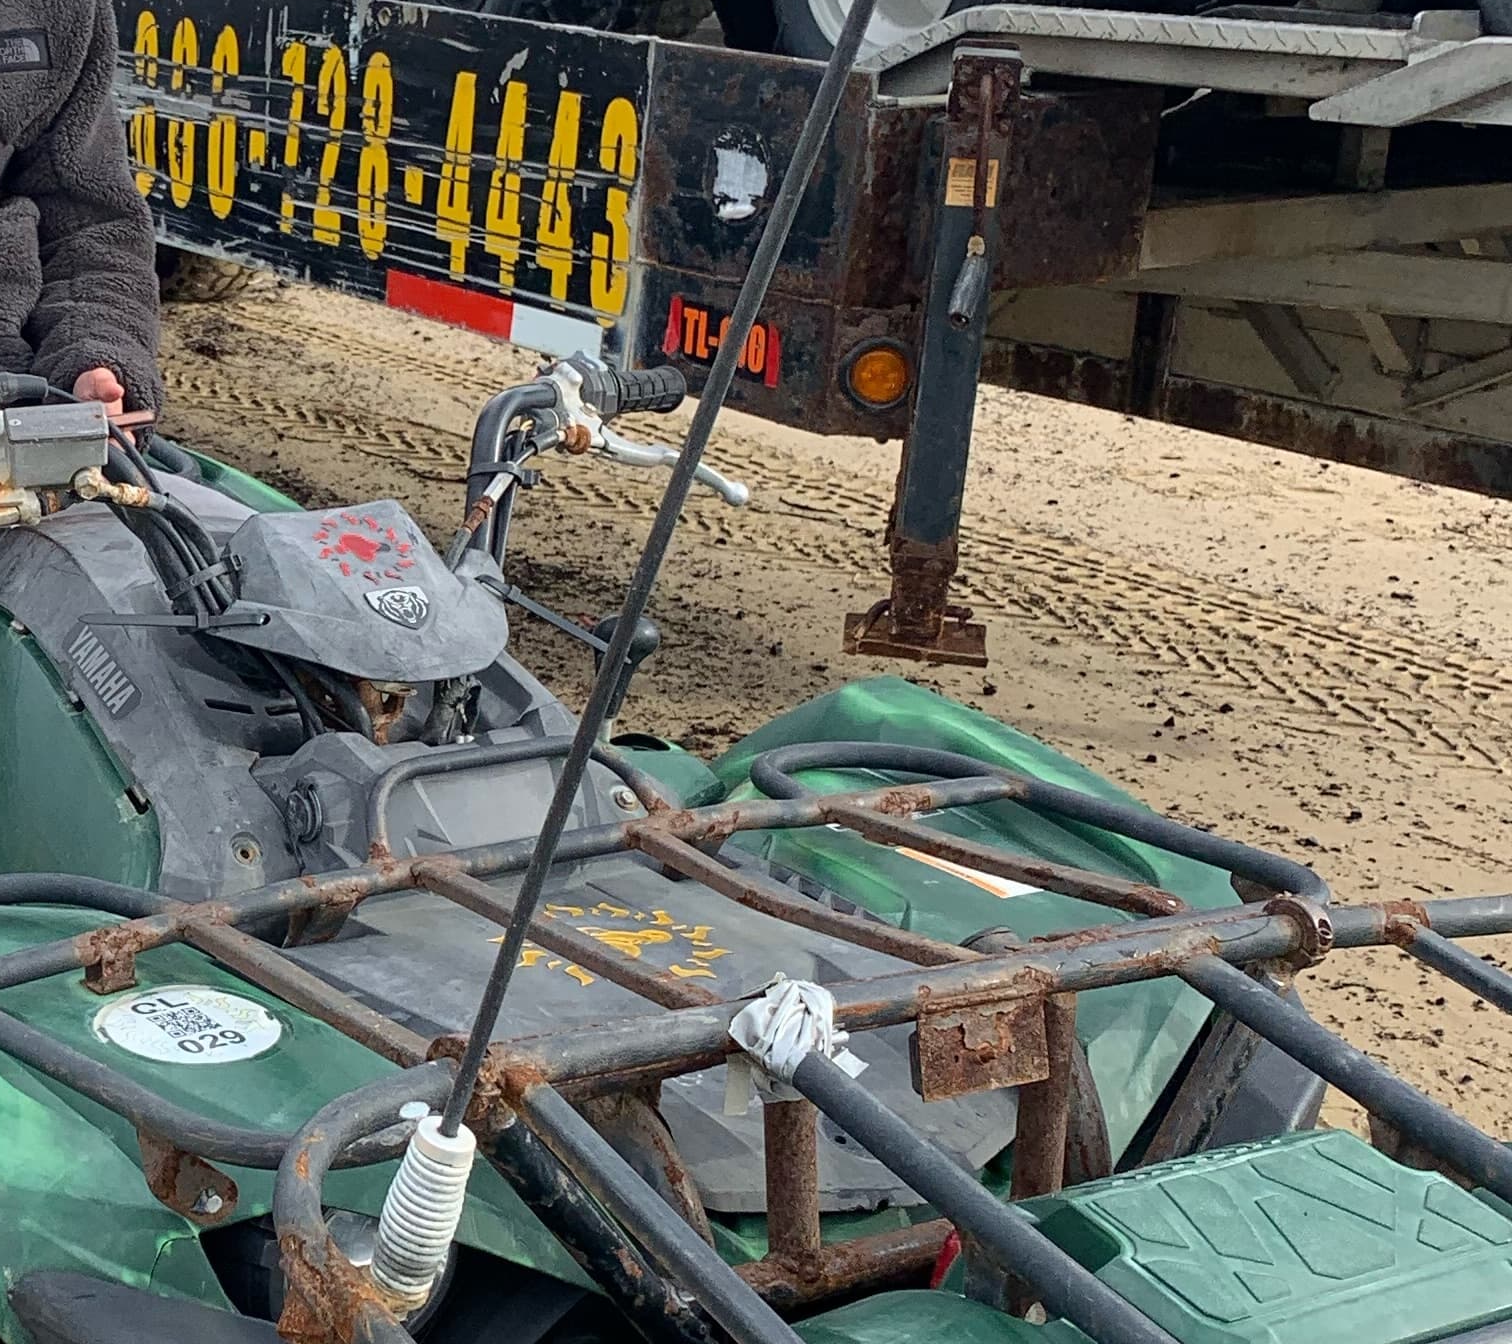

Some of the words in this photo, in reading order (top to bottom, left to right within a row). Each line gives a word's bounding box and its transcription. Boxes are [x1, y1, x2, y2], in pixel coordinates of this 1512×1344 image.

[2, 54, 25, 64] FACE
[683, 306, 766, 374] TL-0
[68, 624, 136, 714] YAMAHA
[177, 1029, 246, 1054] 029
